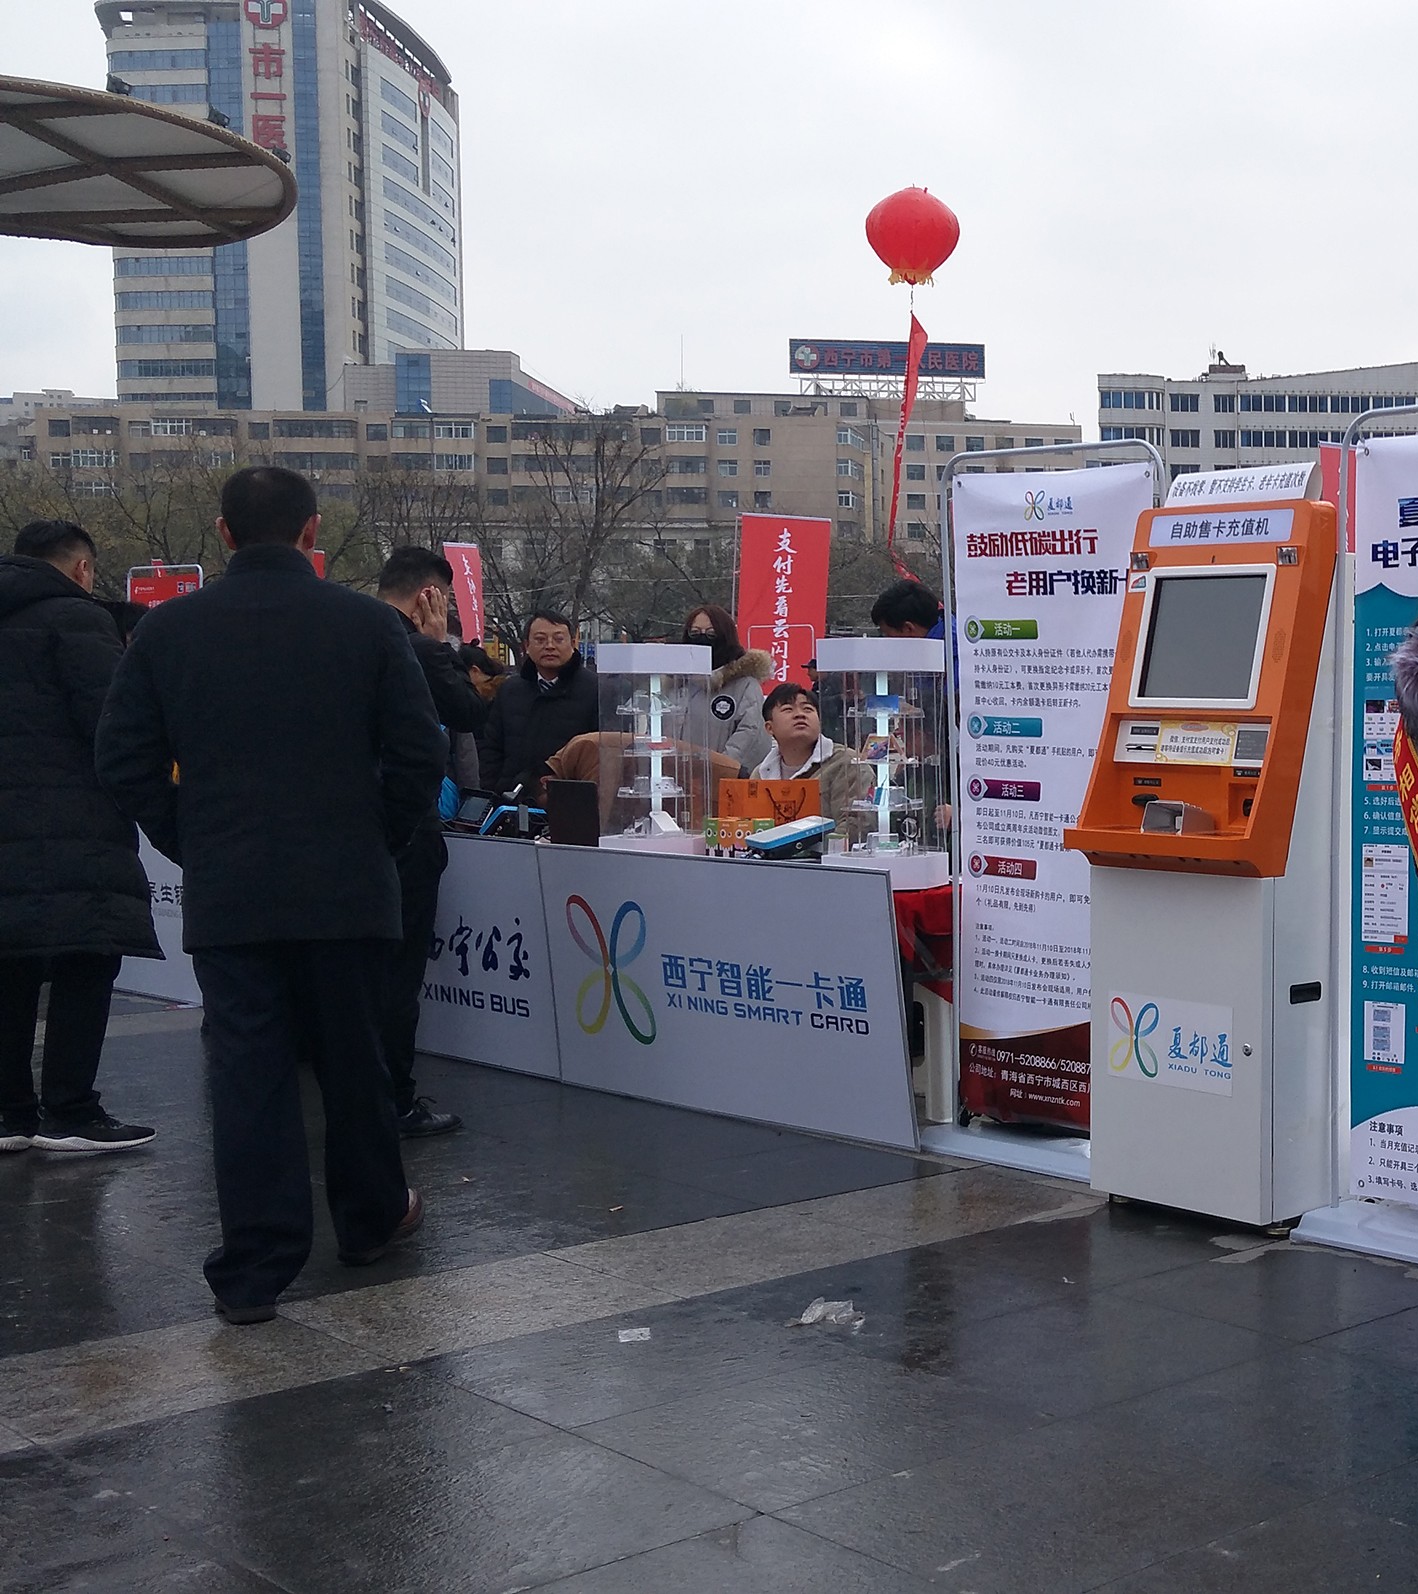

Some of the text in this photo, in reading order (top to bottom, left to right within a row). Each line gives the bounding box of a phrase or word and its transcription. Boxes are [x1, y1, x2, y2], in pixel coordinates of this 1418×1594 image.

[248, 43, 287, 149] 市一医
[824, 348, 980, 371] 西宁市第一民医院
[1170, 517, 1270, 540] 自助售卡充值机
[966, 529, 1099, 558] 鼓励低碳出行
[772, 527, 798, 683] 支付先看云闪付
[993, 622, 1021, 637] 活动一
[993, 721, 1021, 735] 活动二
[1001, 783, 1025, 798] 活动三
[997, 861, 1023, 876] 活动四
[660, 952, 869, 1015] 西宁智能一卡通
[423, 981, 531, 1019] XINING BUS
[667, 991, 870, 1036] XI NING SMART CARD
[1168, 1026, 1234, 1069] 夏都通
[1168, 1062, 1232, 1080] XIADU TONG
[1369, 1120, 1404, 1137] 注意事项
